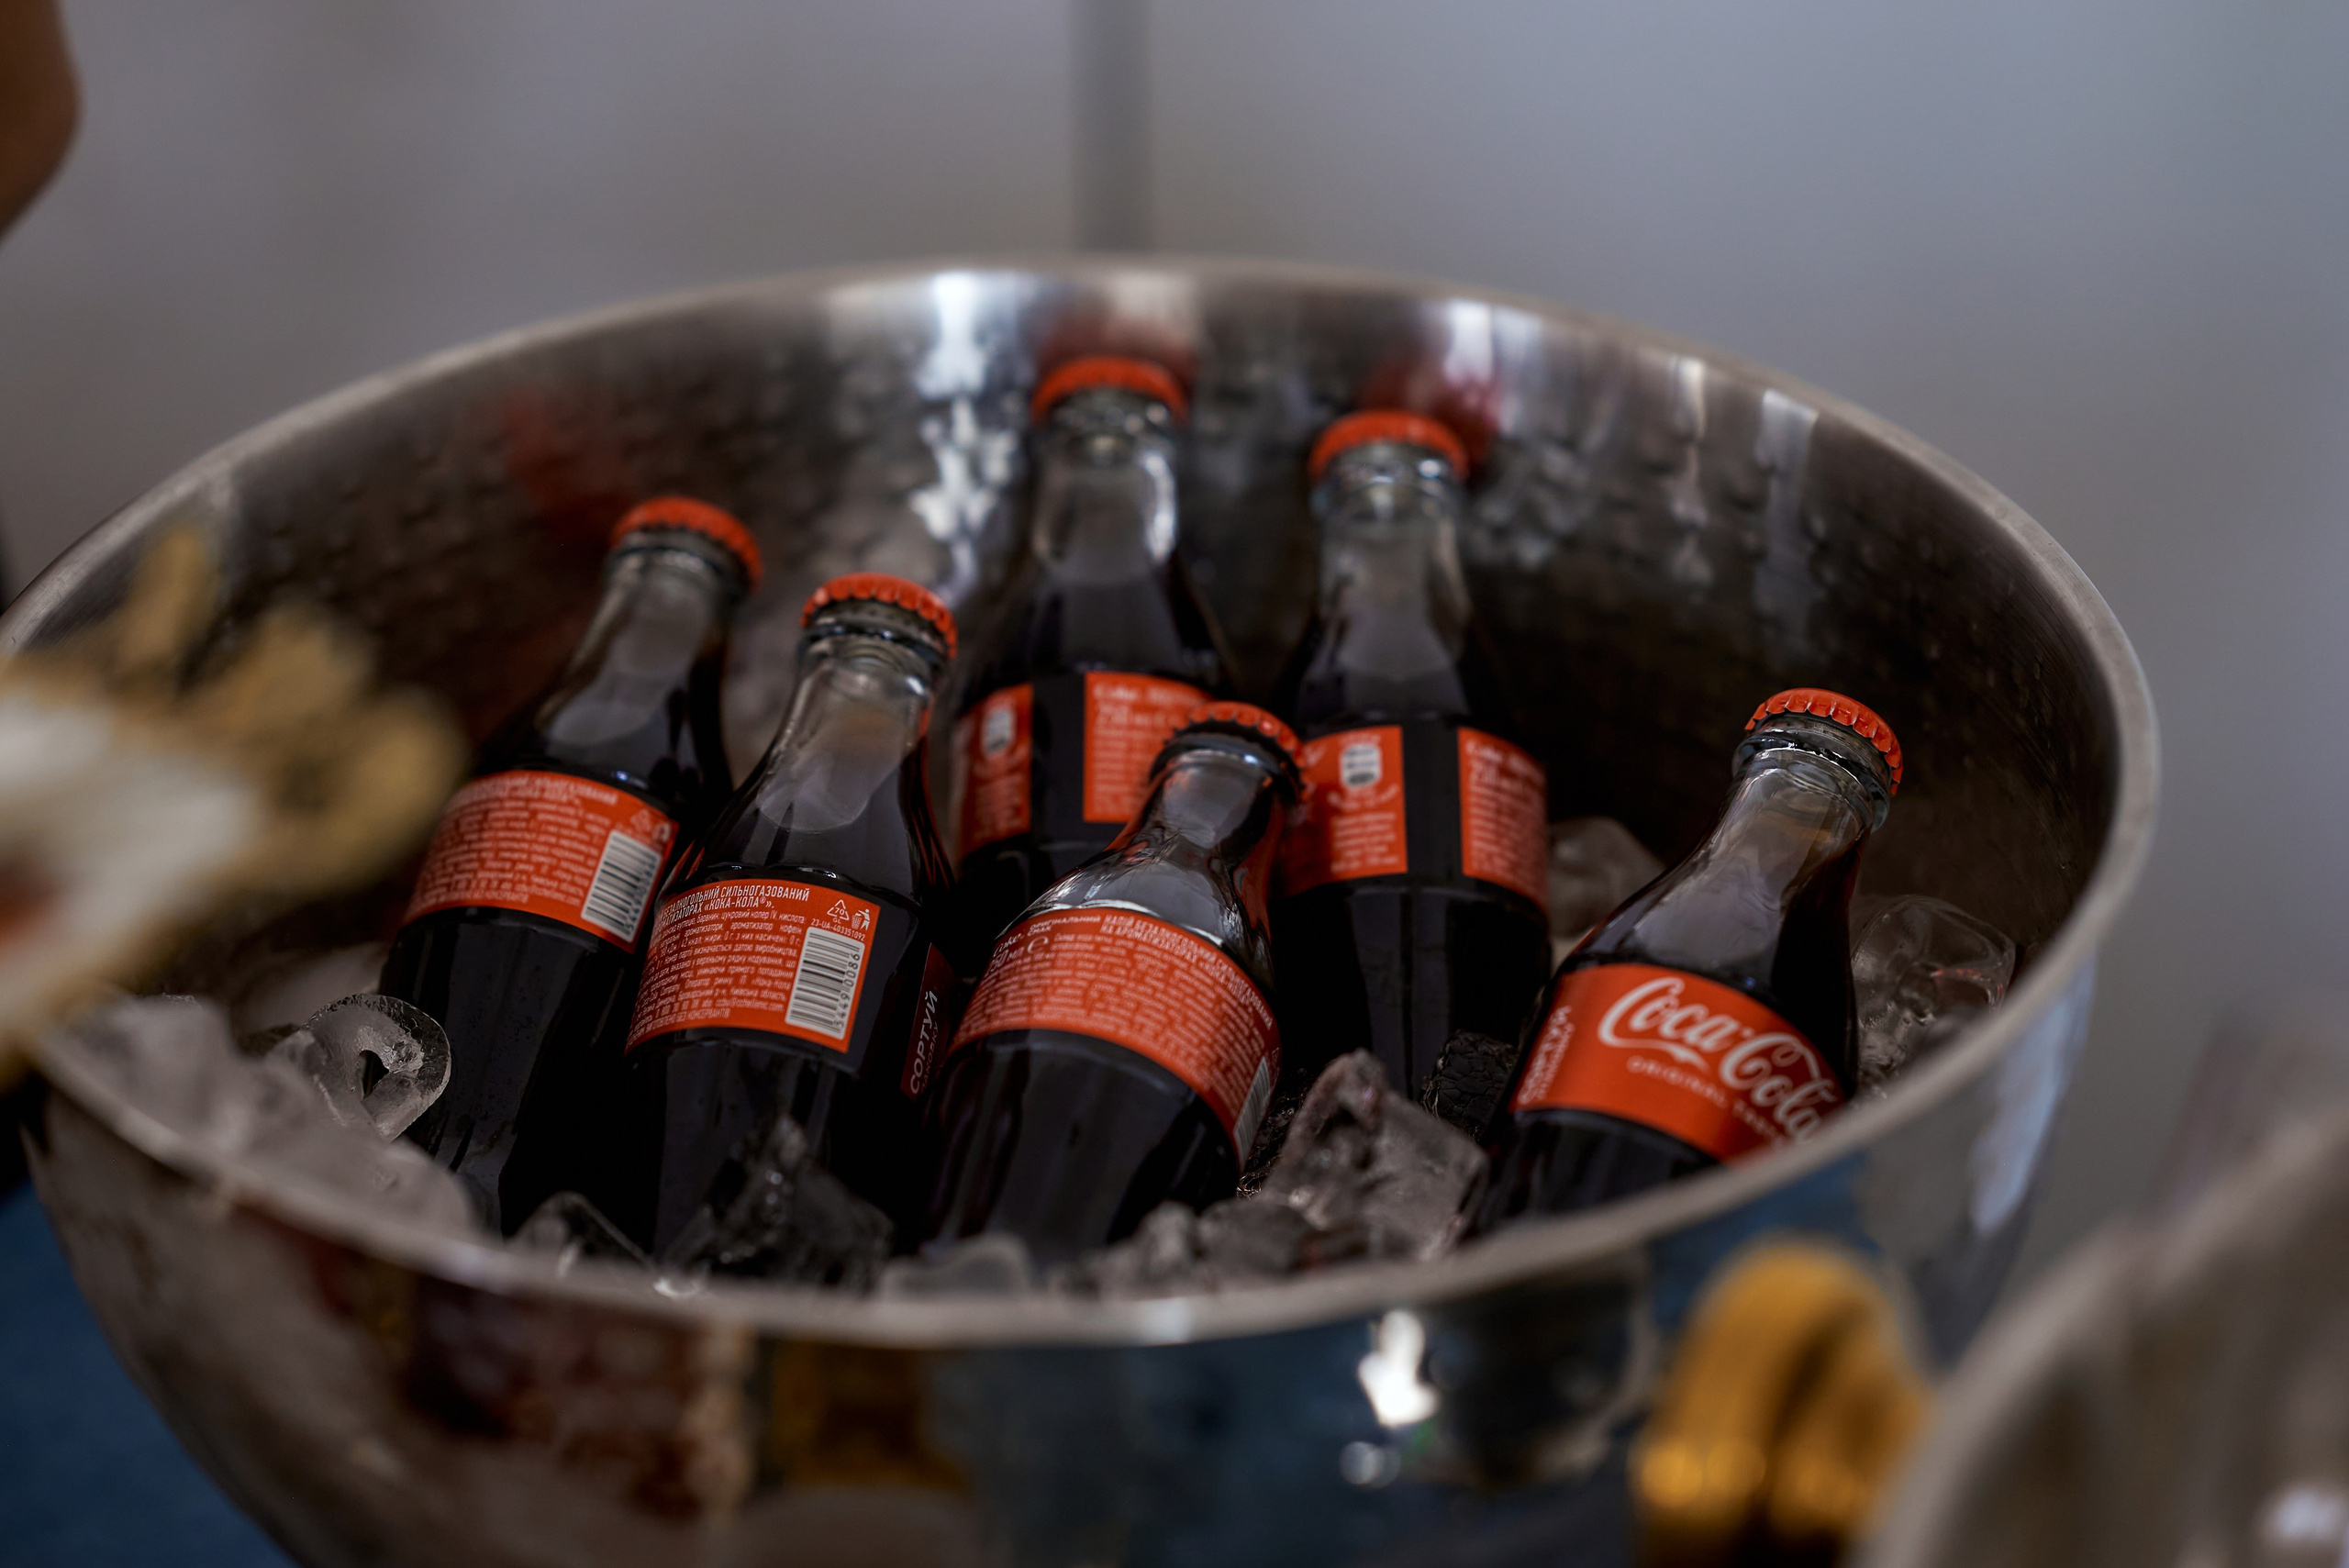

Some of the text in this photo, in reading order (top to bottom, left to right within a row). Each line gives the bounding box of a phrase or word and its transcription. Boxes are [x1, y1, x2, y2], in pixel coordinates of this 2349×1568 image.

[720, 884, 810, 902] СИЛЬНОГАЗОВАНИЙ
[834, 907, 845, 916] 70
[910, 990, 938, 1094] СОРТУЙ
[920, 1020, 939, 1094] ПАКОВКУ
